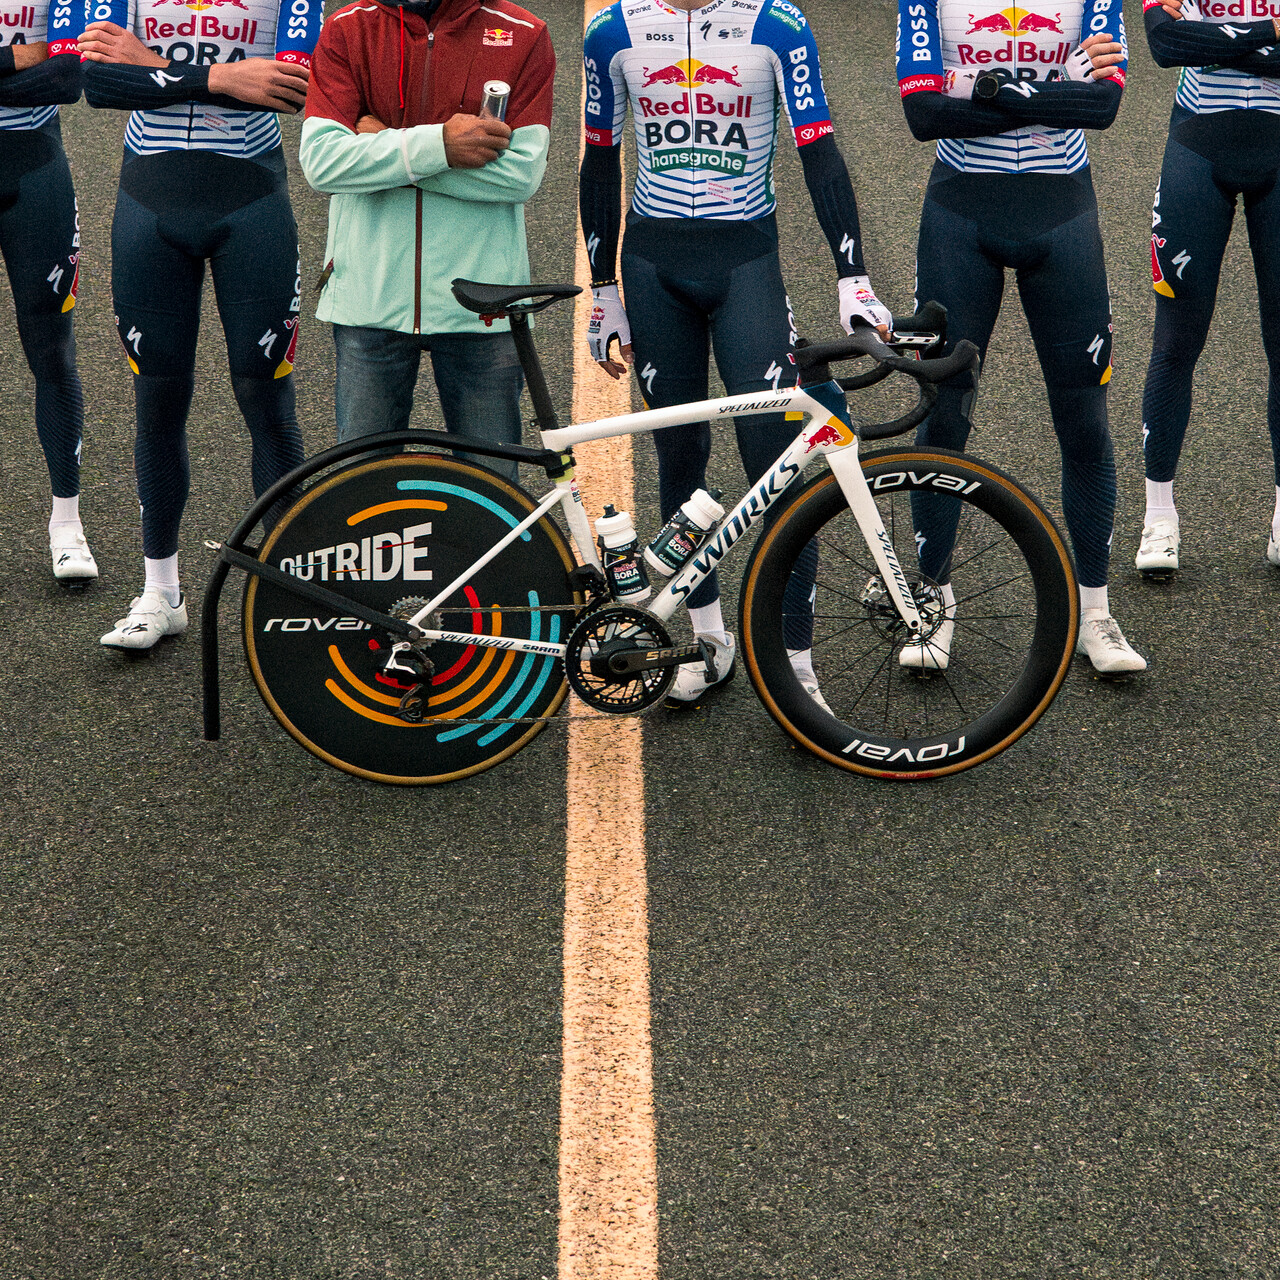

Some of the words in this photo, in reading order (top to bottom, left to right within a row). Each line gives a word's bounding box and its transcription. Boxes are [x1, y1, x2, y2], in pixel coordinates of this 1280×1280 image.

[701, 0, 724, 16] BORA
[772, 0, 807, 27] BORA
[145, 15, 197, 41] Red
[200, 15, 258, 45] Bull
[646, 33, 675, 42] BOSS
[909, 3, 932, 62] BOSS
[957, 40, 1013, 66] Red
[1018, 41, 1070, 65] Bull
[584, 55, 602, 116] BOSS
[789, 45, 815, 111] BOSS
[638, 92, 690, 118] Red
[696, 92, 753, 118] Bull
[645, 119, 749, 151] BORA
[650, 148, 743, 171] hansgrohe
[719, 398, 792, 414] SPECIALIZED
[865, 471, 982, 496] oval
[671, 451, 800, 606] S-WORKS
[279, 521, 433, 582] OUTRIDE
[614, 568, 639, 580] BORA
[876, 528, 915, 610] SPECIALIZED
[441, 631, 515, 649] SPECIALIZED
[522, 643, 560, 654] SRAM
[646, 645, 699, 661] SRAM
[842, 736, 966, 762] roval
